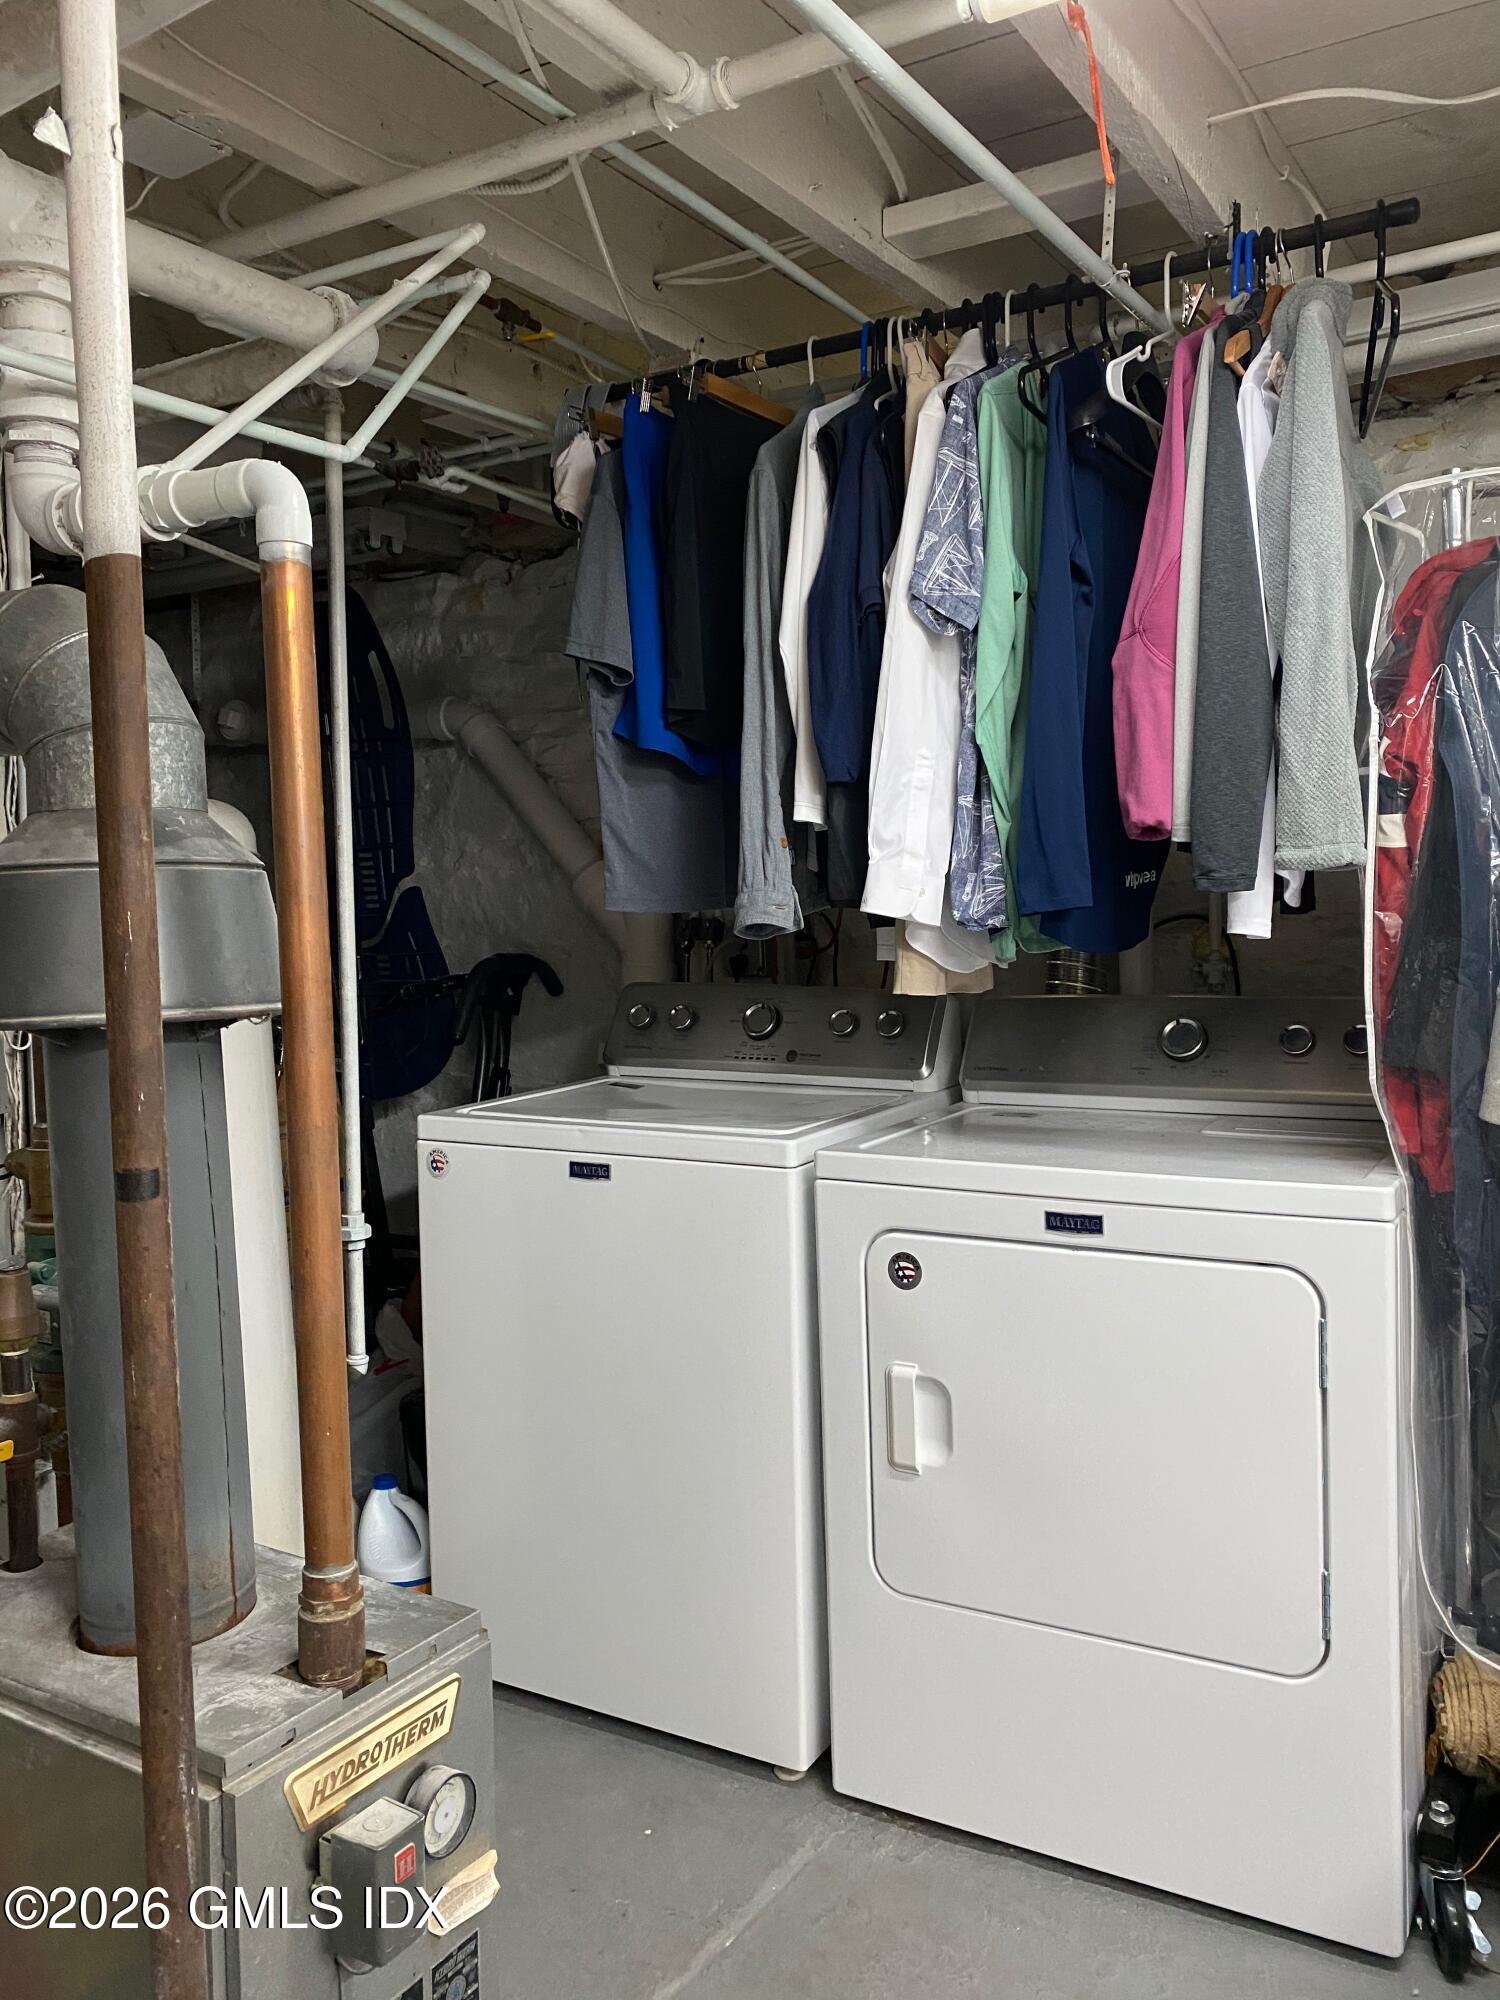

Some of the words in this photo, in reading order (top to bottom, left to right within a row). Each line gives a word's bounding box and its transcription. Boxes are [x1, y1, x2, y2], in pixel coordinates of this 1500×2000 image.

[572, 1164, 608, 1176] MAYTAG
[1049, 1215, 1101, 1230] MAYTAG
[308, 1699, 448, 1813] HYDROTHERM
